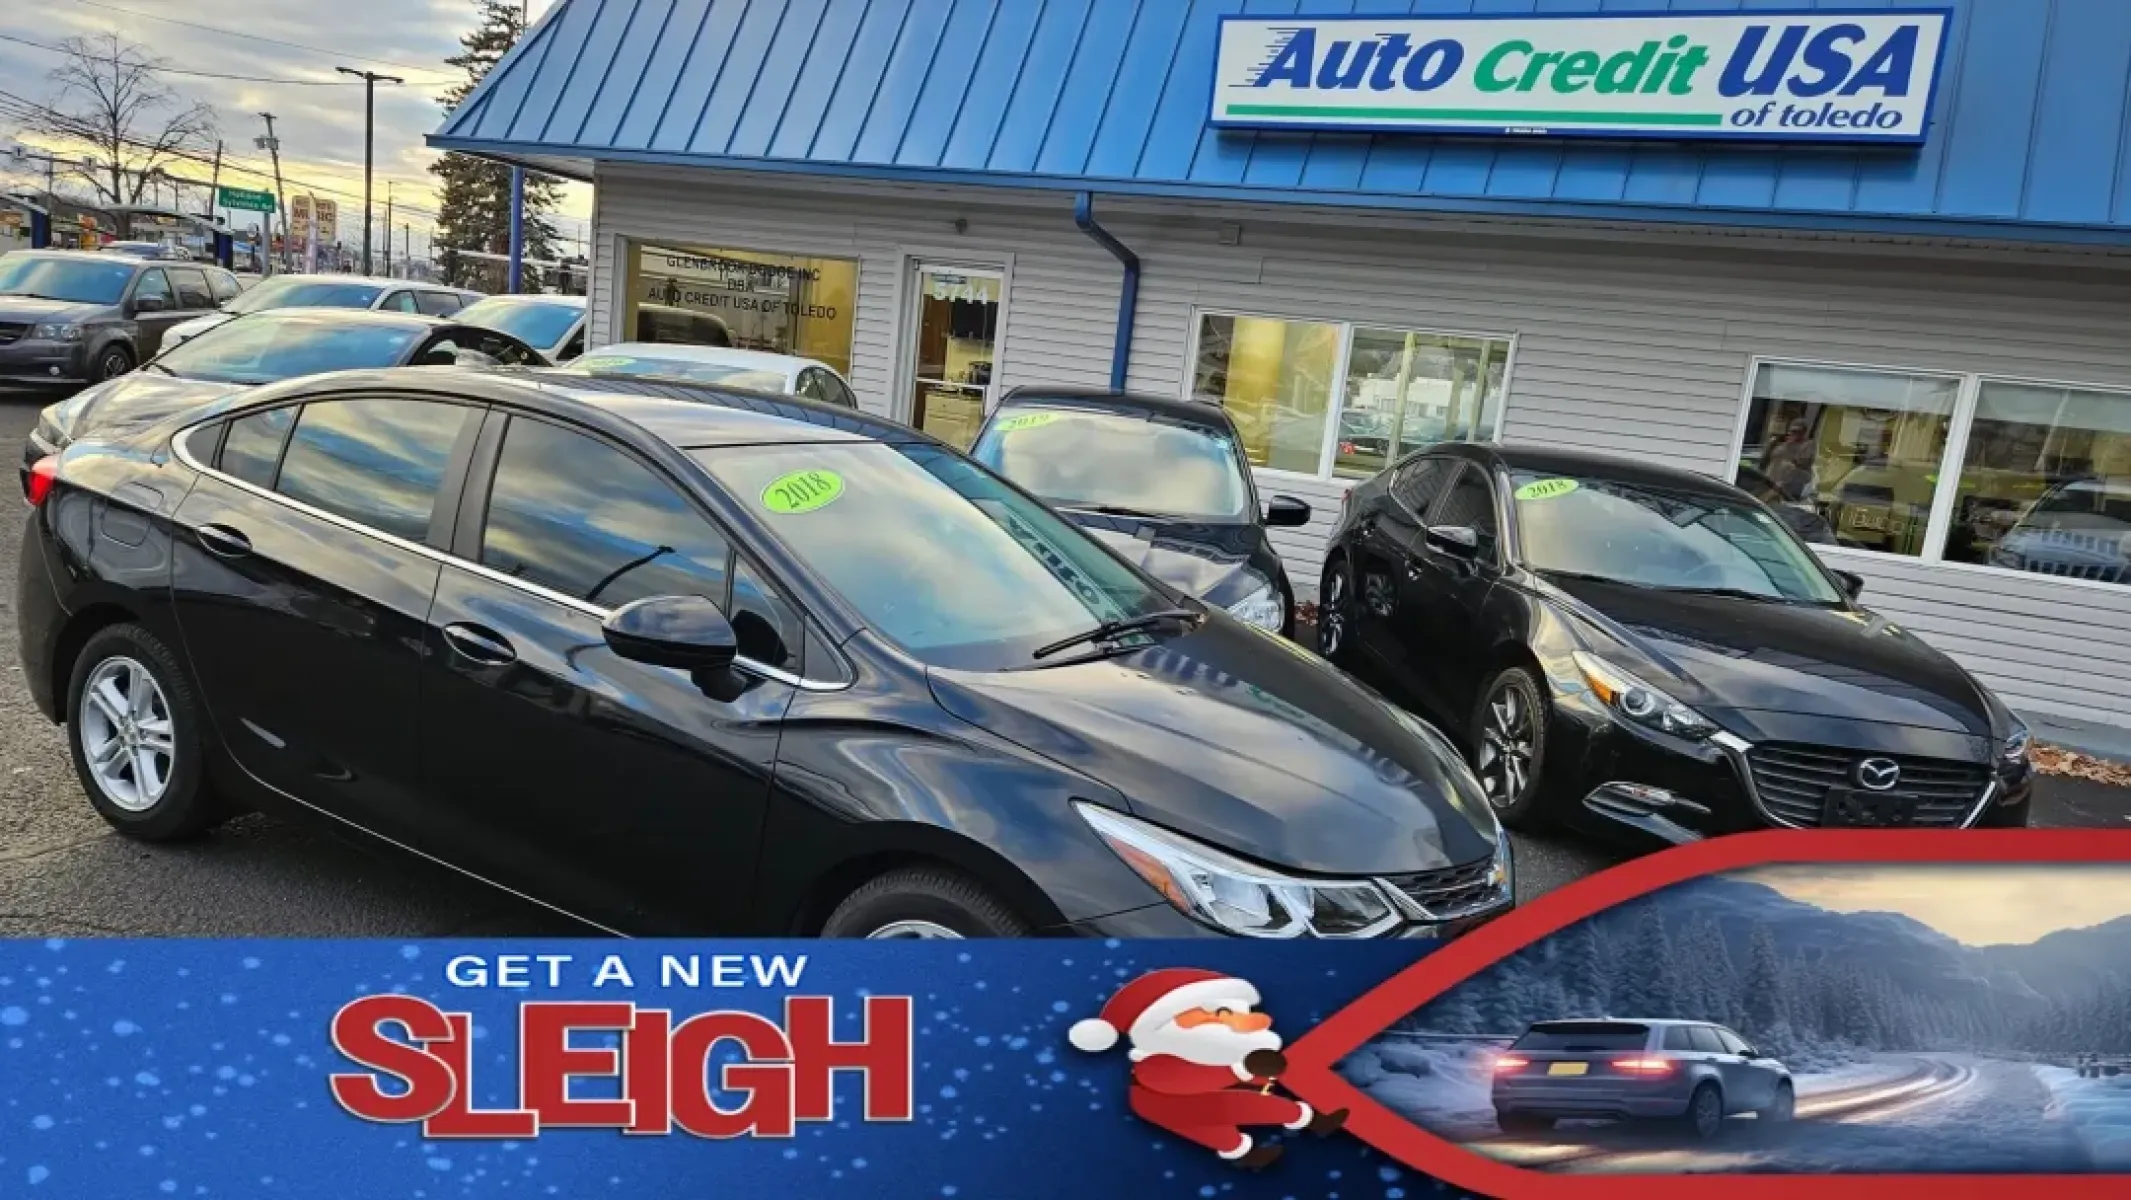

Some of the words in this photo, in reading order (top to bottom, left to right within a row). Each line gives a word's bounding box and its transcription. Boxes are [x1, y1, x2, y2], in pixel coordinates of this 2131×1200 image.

[1247, 27, 1465, 92] Auto
[1472, 34, 1709, 96] Credit
[1717, 23, 1920, 98] USA
[1730, 101, 1776, 128] of
[1779, 102, 1903, 129] toledo
[727, 277, 754, 293] DBA
[798, 266, 821, 282] INC
[685, 291, 729, 309] CREDIT
[733, 298, 759, 313] USA
[761, 300, 780, 314] OF
[783, 301, 836, 320] TOLEDO
[932, 282, 988, 305] 5744
[774, 472, 832, 509] 2018
